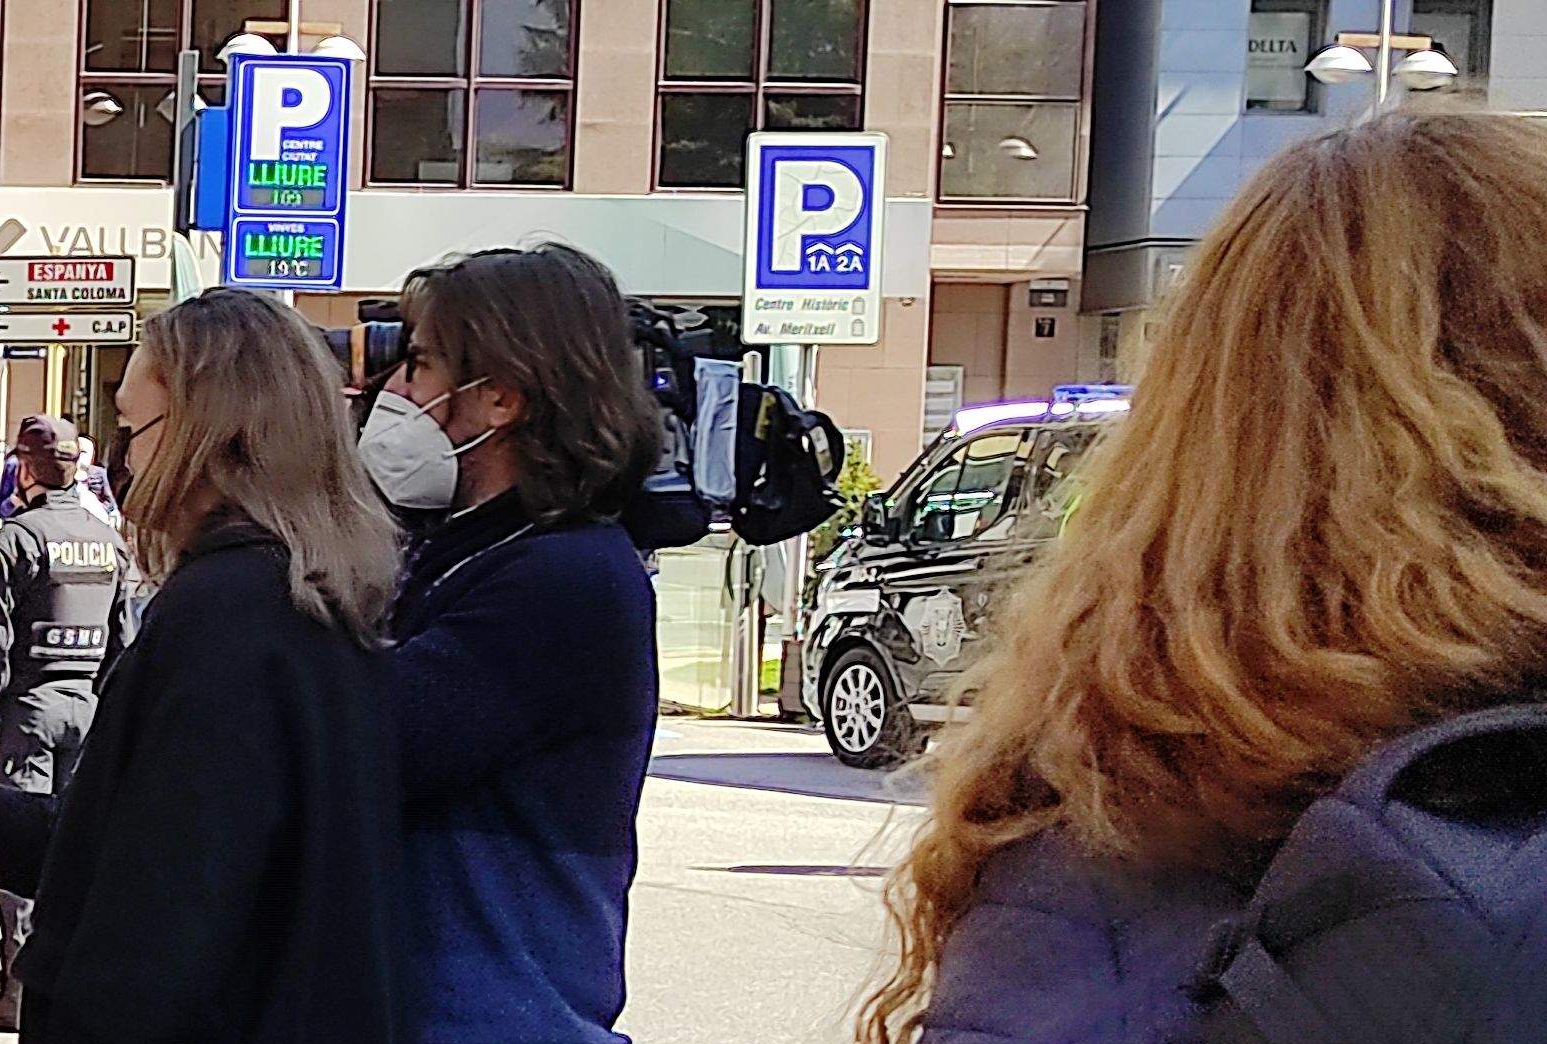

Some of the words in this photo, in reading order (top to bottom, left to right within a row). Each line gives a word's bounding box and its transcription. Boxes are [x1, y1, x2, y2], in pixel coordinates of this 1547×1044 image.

[250, 66, 332, 161] P
[249, 163, 327, 187] LLIURE
[772, 160, 864, 271] P
[245, 234, 324, 258] LLIURE
[32, 262, 108, 281] ESPANYA
[808, 255, 831, 272] 1A
[836, 255, 864, 272] 2A
[27, 287, 68, 300] SANTA
[71, 287, 126, 300] COLOMA
[46, 541, 117, 567] POLICIA
